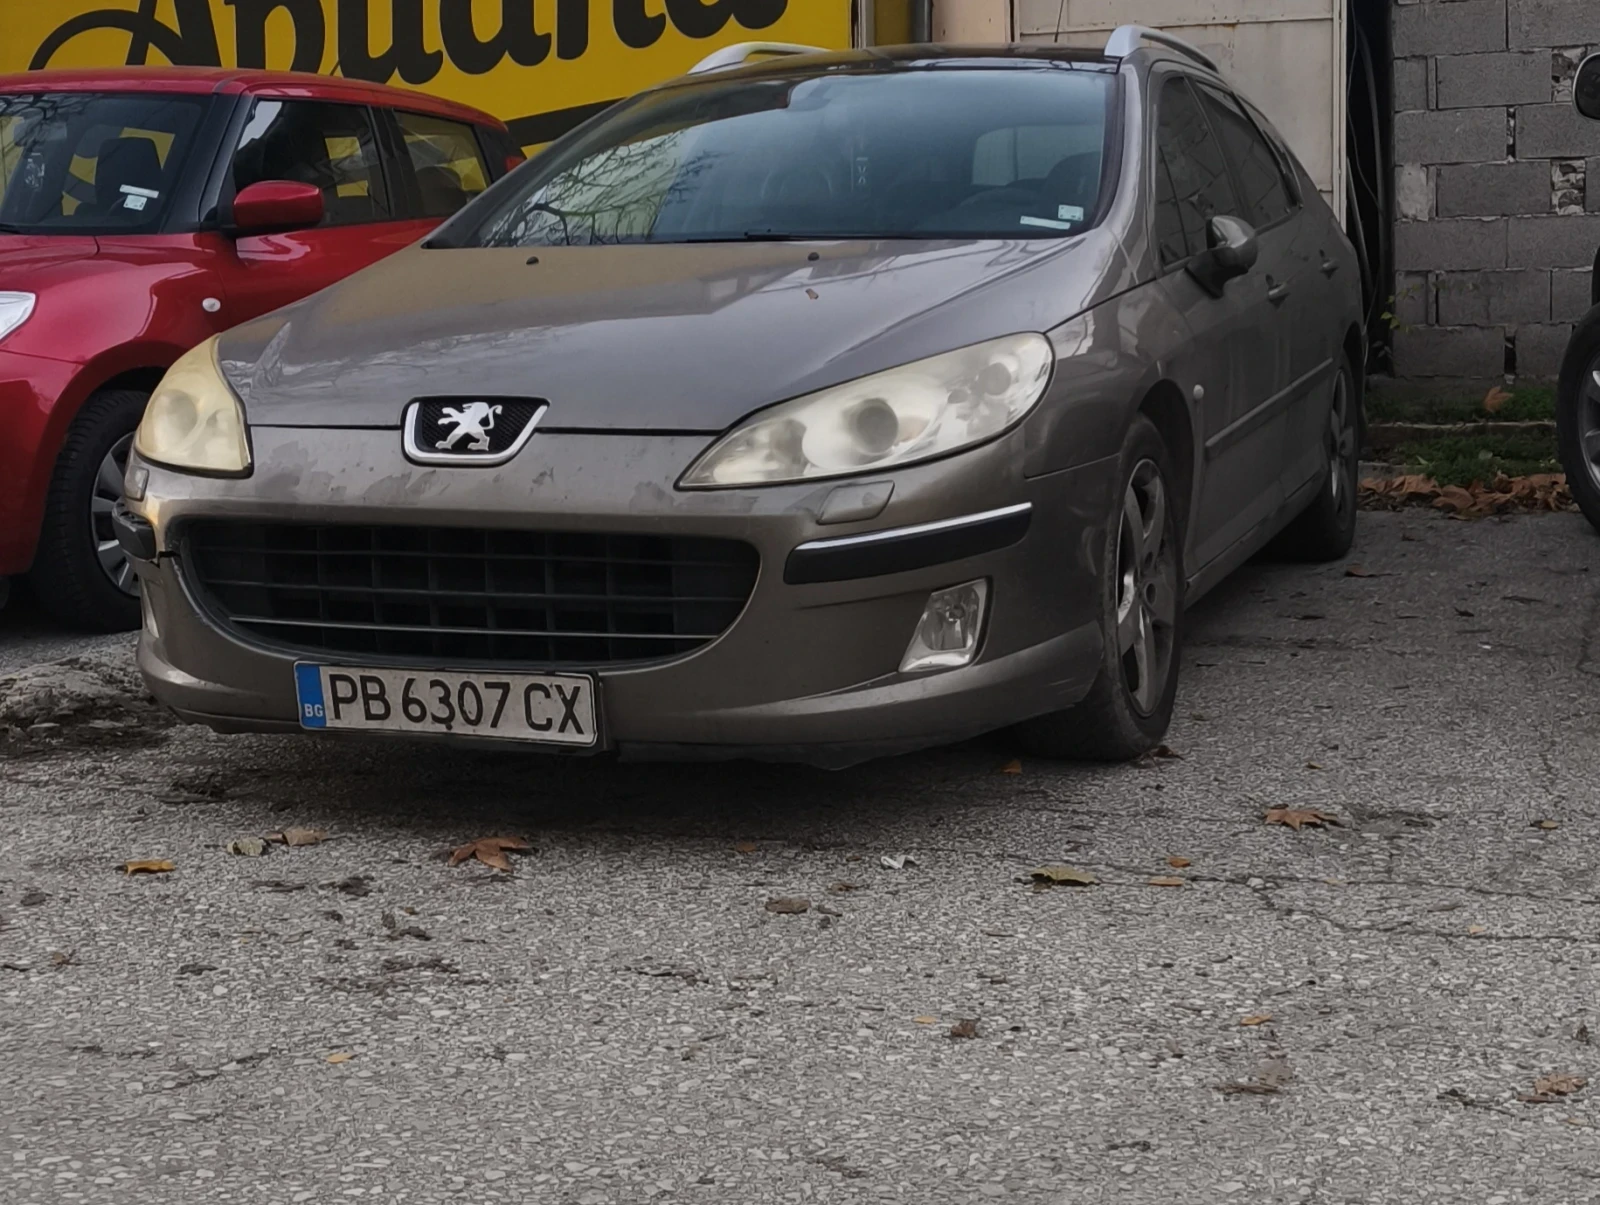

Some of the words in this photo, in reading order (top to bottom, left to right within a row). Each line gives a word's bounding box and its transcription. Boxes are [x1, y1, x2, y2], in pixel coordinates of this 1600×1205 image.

[304, 703, 324, 717] BG
[328, 674, 392, 721] PB
[401, 678, 511, 729] 6307
[524, 682, 585, 735] CX
